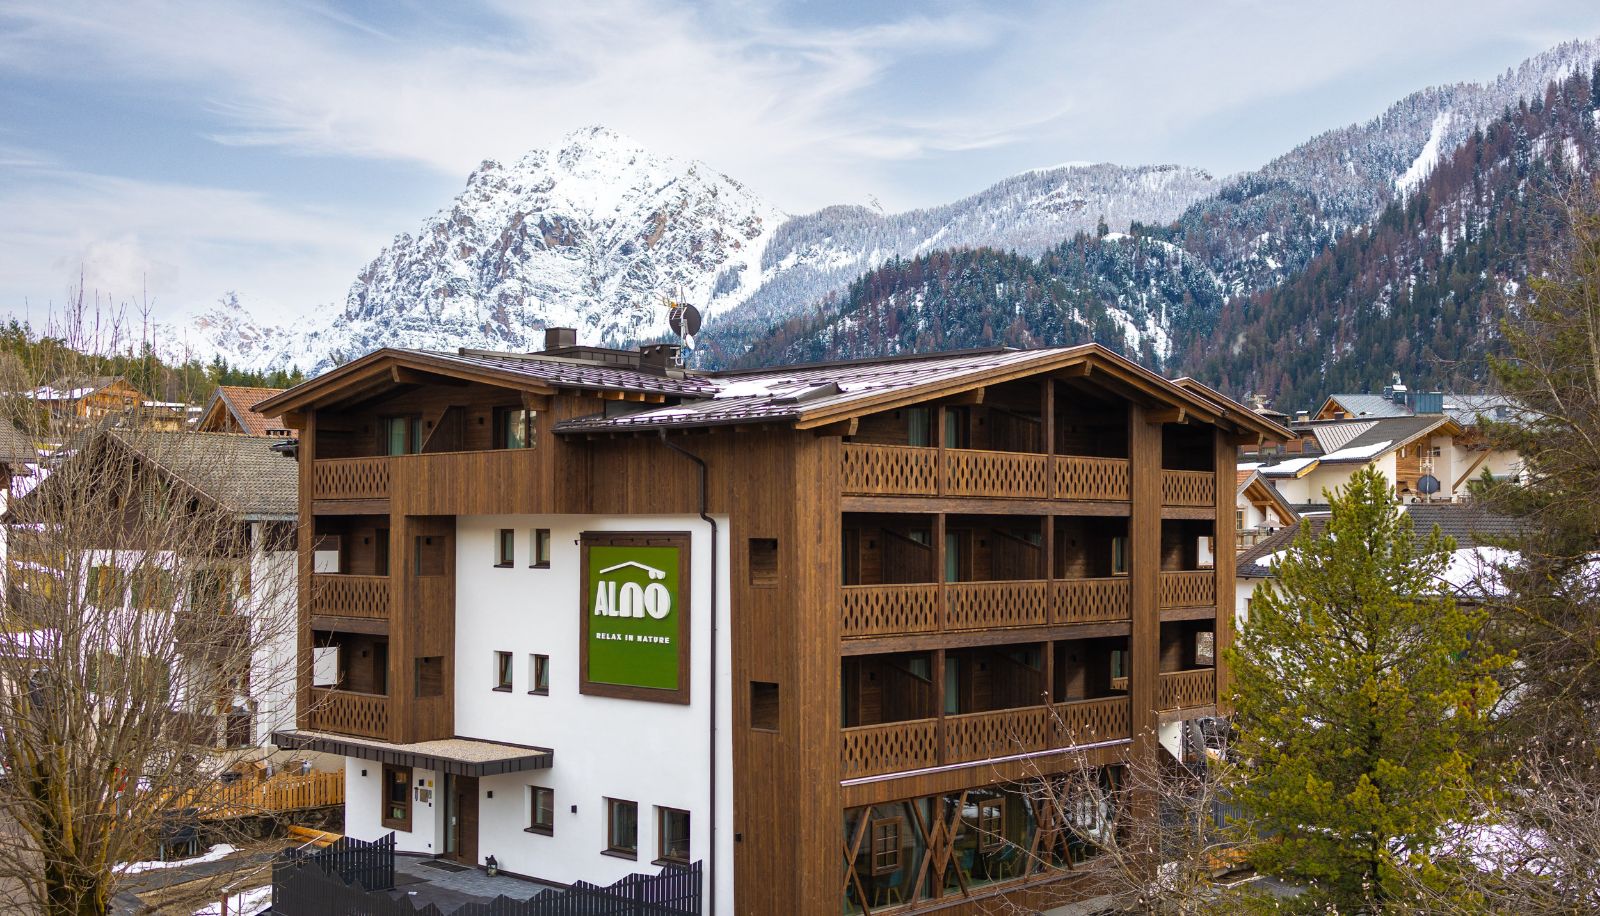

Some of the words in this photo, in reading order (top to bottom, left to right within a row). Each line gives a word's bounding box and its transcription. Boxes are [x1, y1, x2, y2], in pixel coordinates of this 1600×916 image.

[596, 632, 622, 641] RELAX
[624, 634, 634, 642] IN
[637, 635, 670, 644] NATURE
